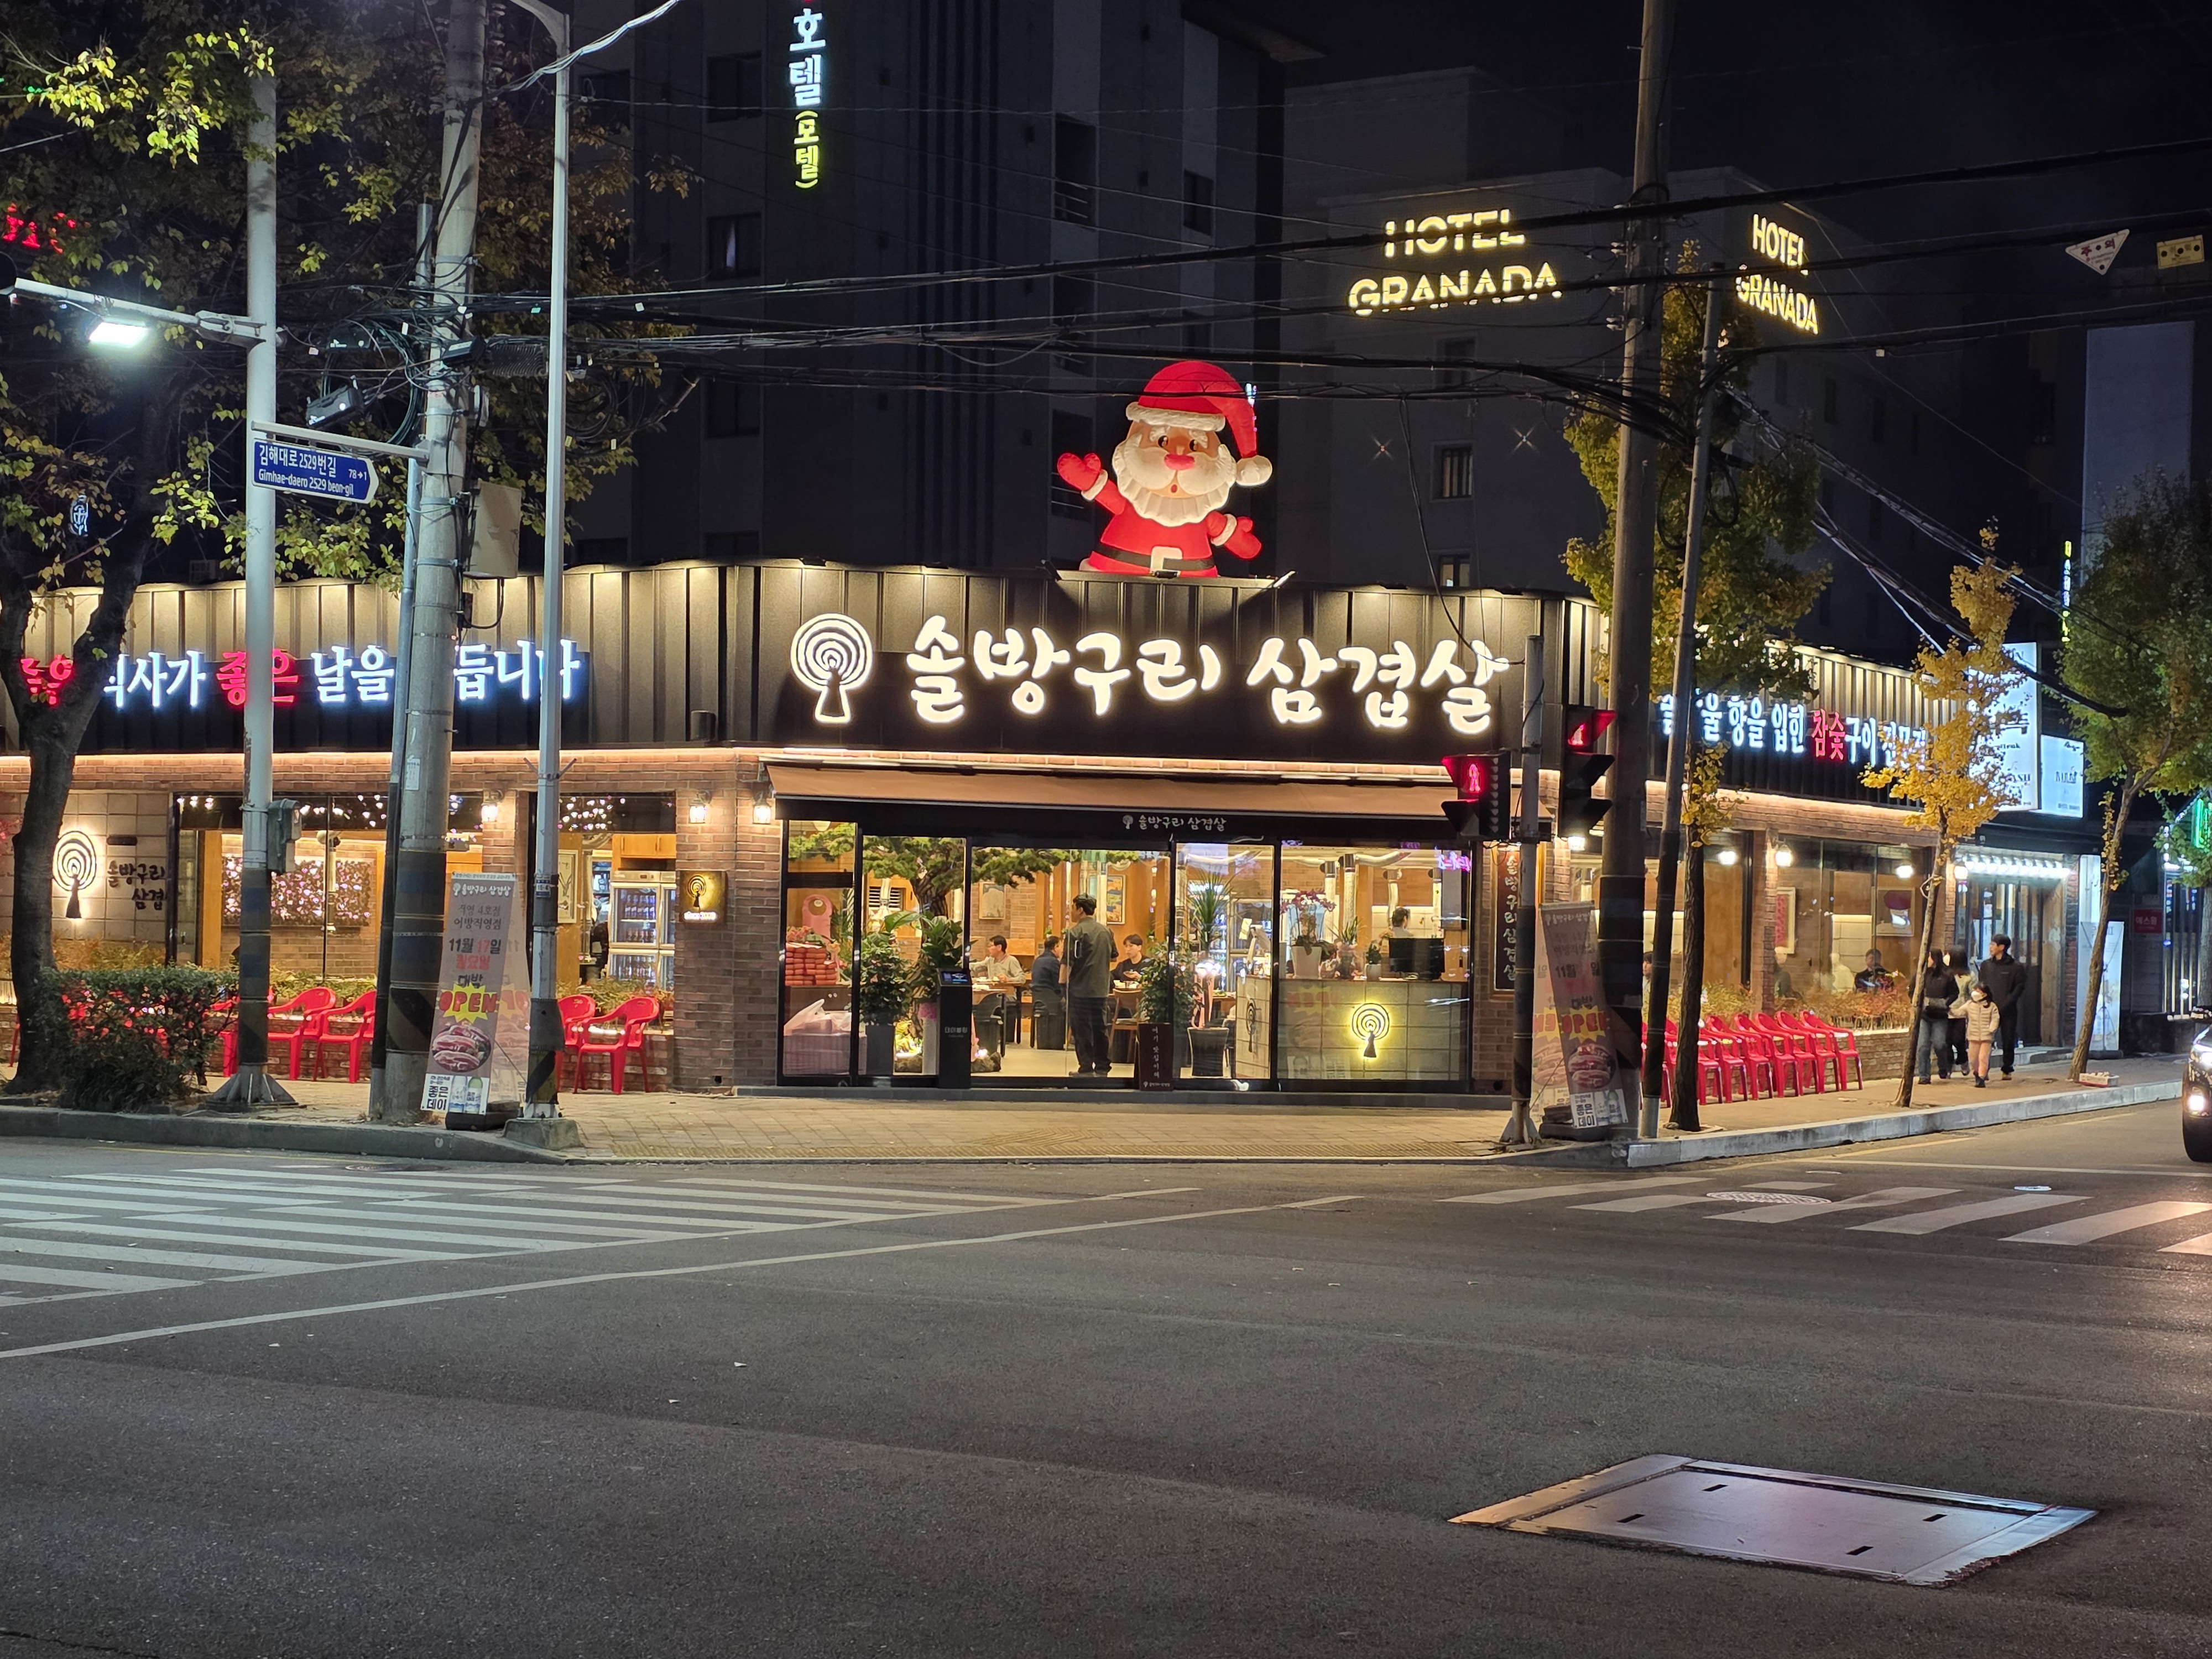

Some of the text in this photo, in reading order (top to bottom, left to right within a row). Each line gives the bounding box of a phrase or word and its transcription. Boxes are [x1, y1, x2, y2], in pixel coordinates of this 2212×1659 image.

[789, 8, 826, 107] 호텔
[1385, 209, 1525, 258] HOTEL
[1753, 213, 1808, 275] HOTEL
[1348, 262, 1563, 316] GRANADA
[1736, 264, 1818, 335] GRANADA
[258, 468, 354, 497] Gimhae-daero 2529 beon-gil
[348, 469, 357, 479] 78
[310, 644, 394, 703] 날을
[453, 639, 580, 701] 듭니다
[906, 614, 1510, 734] 솔방구리 삼겹살
[1728, 695, 1766, 748] 향을
[1772, 703, 1804, 753] 입힌
[1138, 815, 1227, 832] 솔방구리 삼겹살
[107, 860, 165, 888] 솔방구리
[132, 888, 165, 911] 삼겹
[449, 938, 502, 954] 11월 17일
[439, 990, 497, 1013] OPEN
[426, 1098, 447, 1111] 데이
[429, 1086, 449, 1098] 좋은
[1578, 1115, 1595, 1127] 데이
